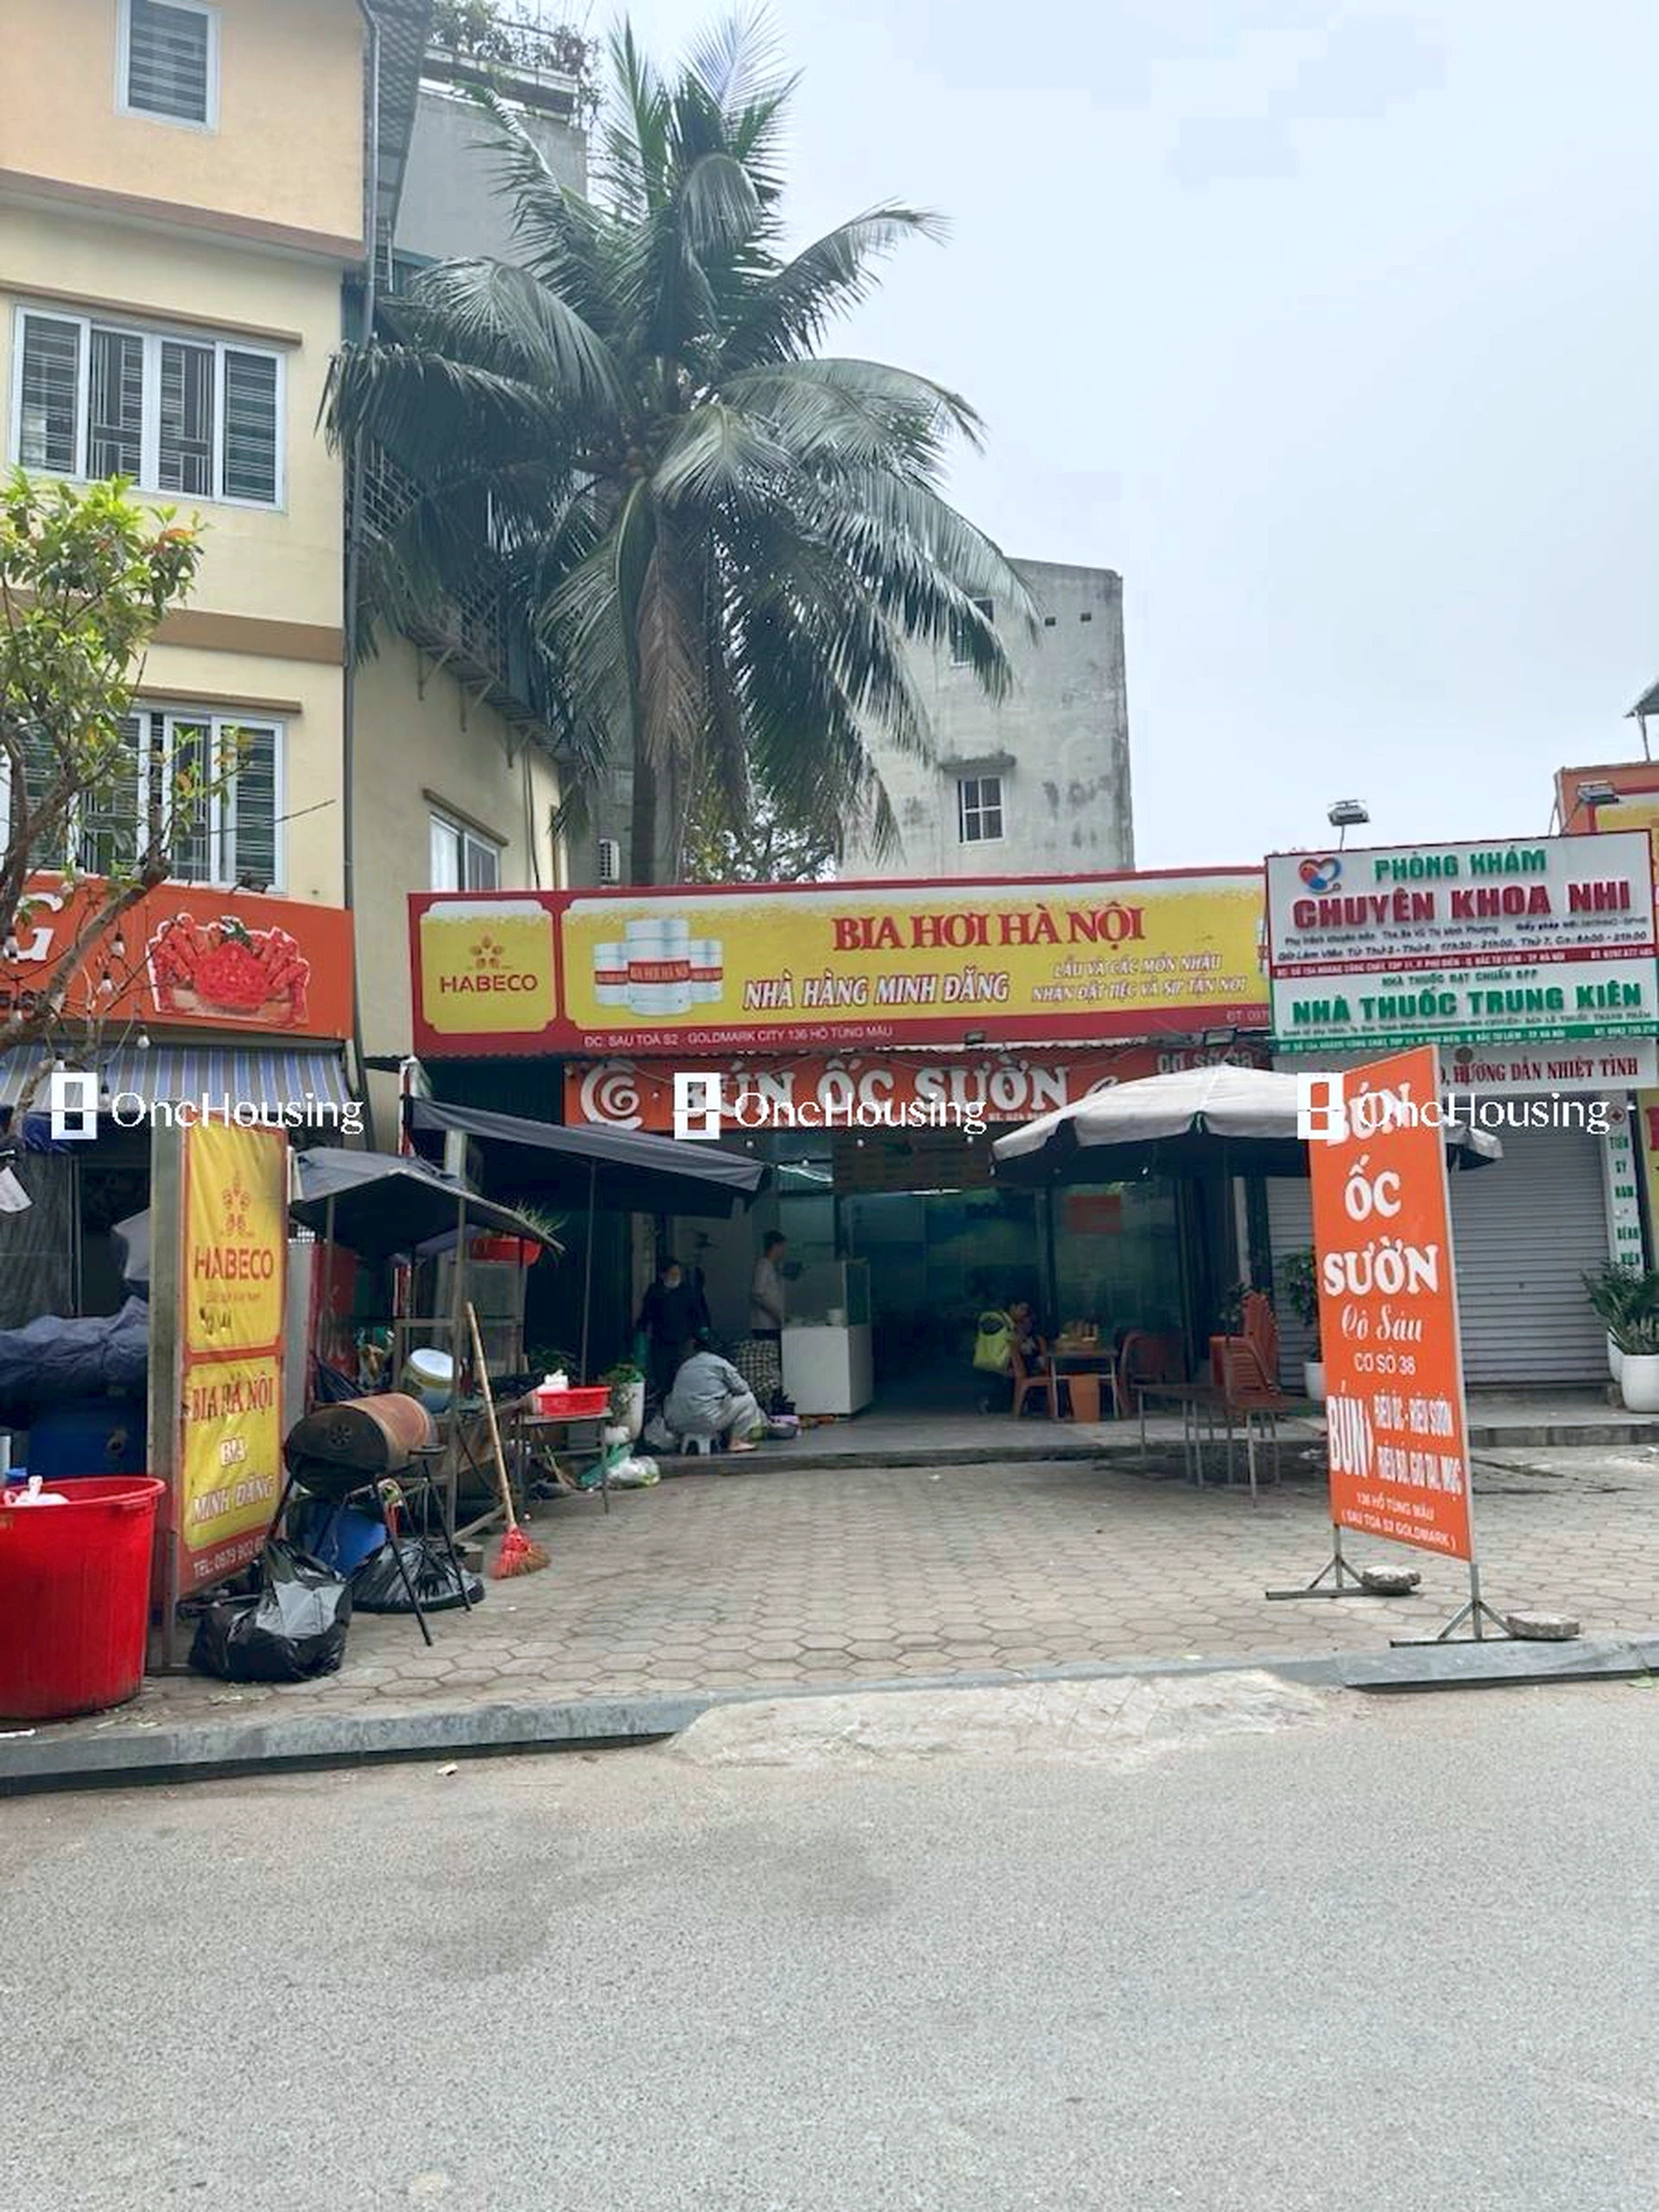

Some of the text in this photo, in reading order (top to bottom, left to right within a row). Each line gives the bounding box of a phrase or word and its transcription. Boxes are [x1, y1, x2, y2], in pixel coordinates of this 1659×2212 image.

[1375, 844, 1548, 883] PHÒNG KHÁM
[833, 901, 1146, 951] BIA HƠI HÀ NỘI
[1293, 880, 1631, 930] CHUYÊN KHOA NHI
[440, 974, 537, 994] HABECO
[743, 966, 1009, 1010] NHÀ HÀNG MINH ĐĂNG
[1293, 979, 1641, 1024] NHÀ THUỐC TRUNG KIÊN
[687, 1030, 756, 1045] GOLDMARK
[817, 1058, 894, 1114] ỐC
[914, 1054, 1069, 1112] SƯỜN
[1345, 1154, 1402, 1221] ỐC
[193, 1245, 274, 1280] HABECO
[1323, 1235, 1439, 1296] SƯỜN
[192, 1385, 217, 1423] BIA
[248, 1372, 274, 1415] NỘI
[1327, 1379, 1368, 1478] BÚN
[220, 1437, 246, 1467] BIA
[192, 1486, 231, 1524] MINH
